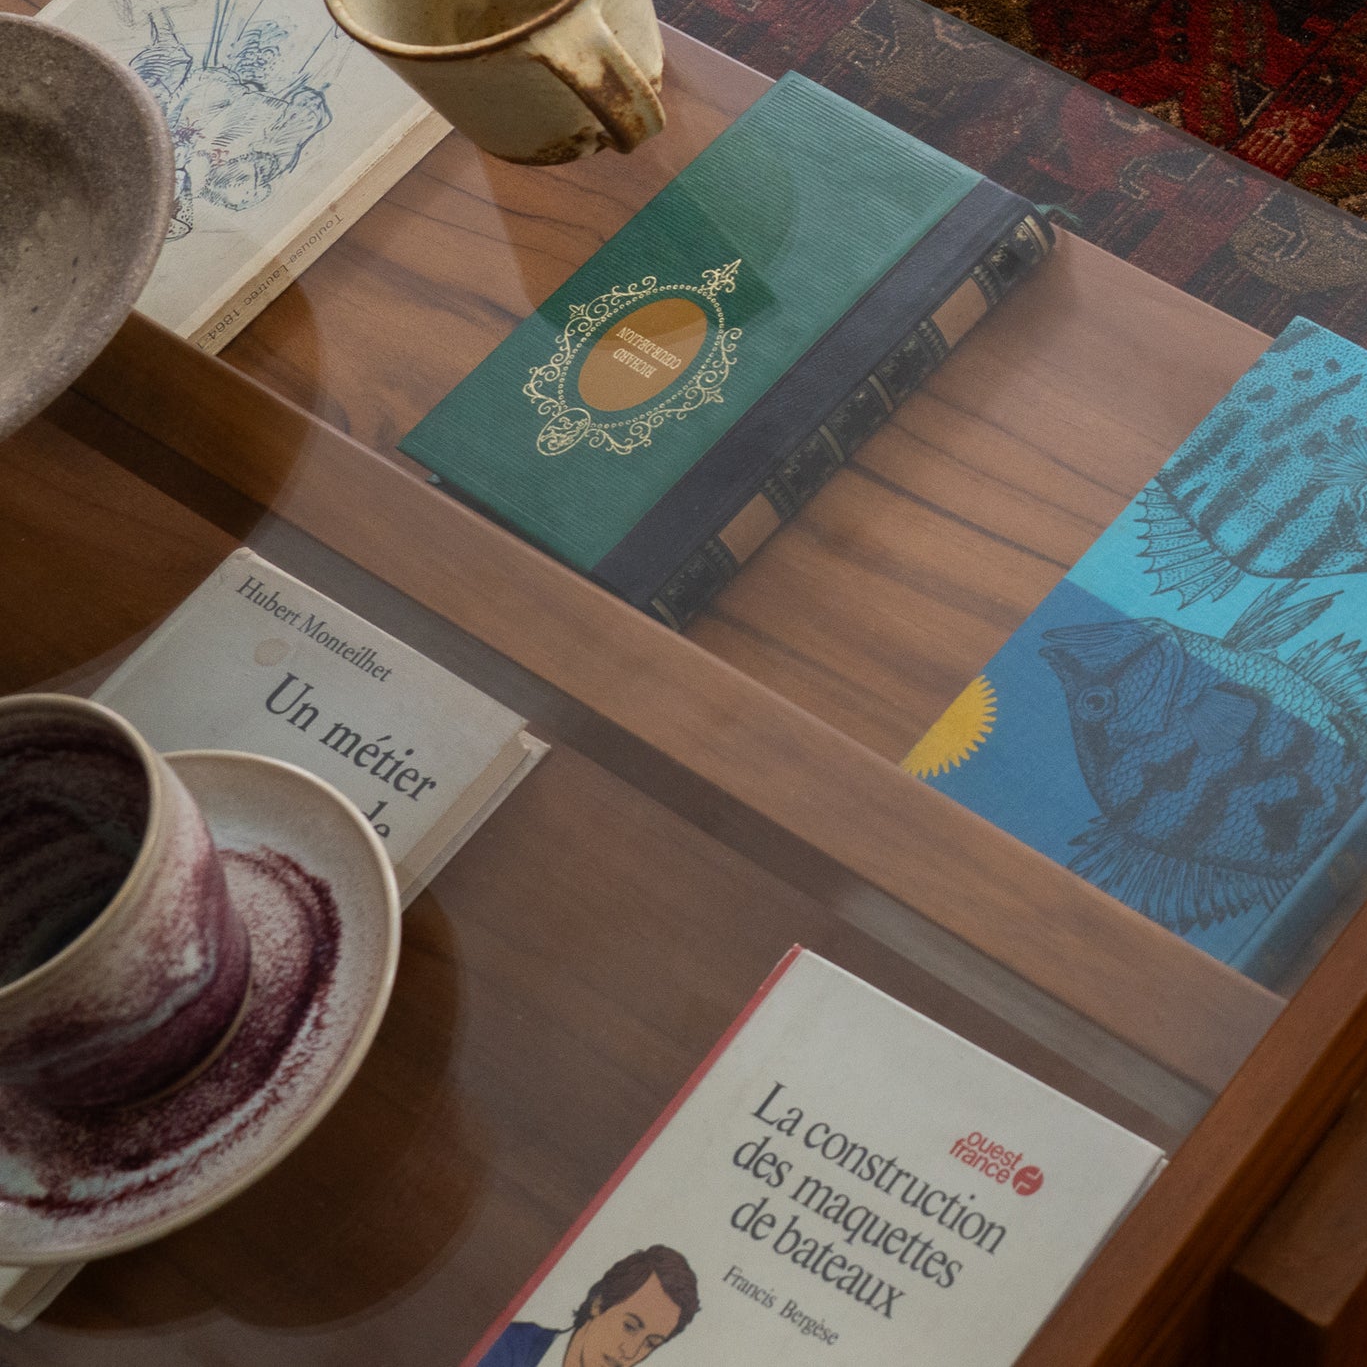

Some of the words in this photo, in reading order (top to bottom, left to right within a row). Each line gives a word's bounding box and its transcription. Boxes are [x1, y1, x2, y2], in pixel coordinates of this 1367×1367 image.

[243, 212, 344, 306] Toulouse-Lautrec
[613, 347, 657, 378] RICHARD
[236, 576, 301, 626] Hubert
[297, 613, 393, 682] Monteilhet
[265, 672, 319, 732] Un
[319, 722, 437, 801] métier
[752, 1081, 804, 1136] La
[803, 1122, 1007, 1255] construction
[950, 1138, 1011, 1184] france
[967, 1131, 1023, 1170] ouest
[730, 1197, 777, 1241] de
[772, 1215, 905, 1319] bateaux
[732, 1136, 793, 1188] des
[789, 1175, 963, 1288] maquettes
[722, 1265, 777, 1309] Francis
[779, 1299, 839, 1345] Bergèse
